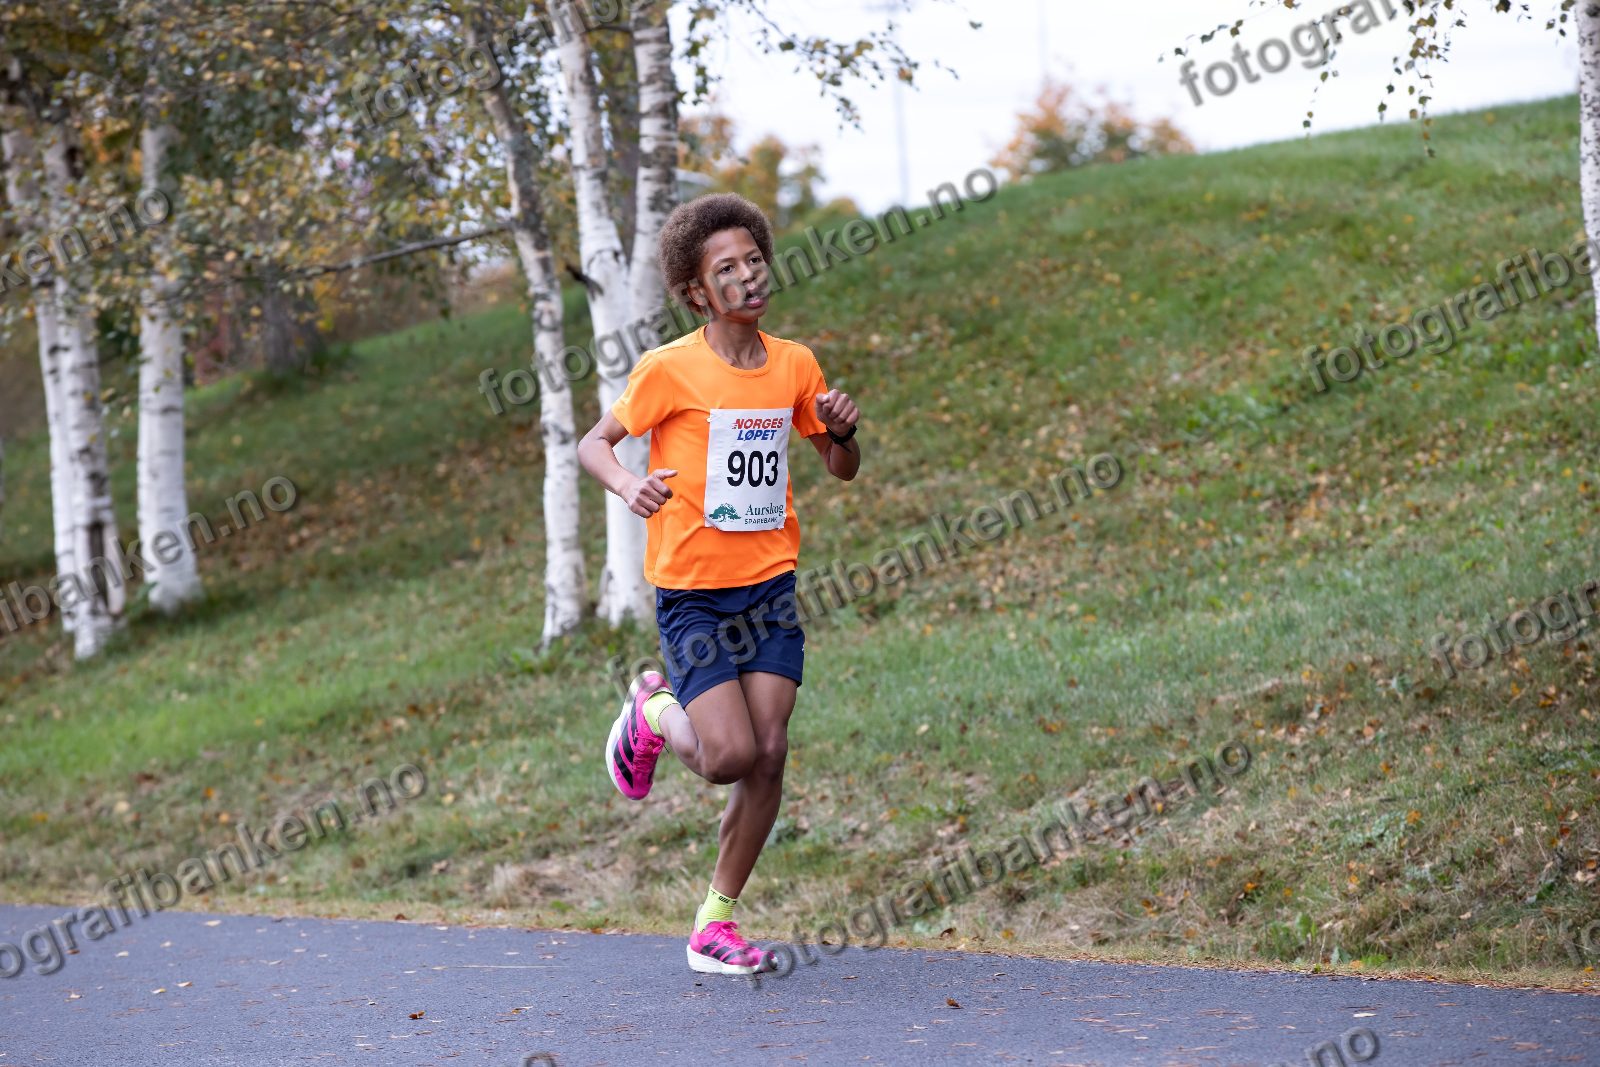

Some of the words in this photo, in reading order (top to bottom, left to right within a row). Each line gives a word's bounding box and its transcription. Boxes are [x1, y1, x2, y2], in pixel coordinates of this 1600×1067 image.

[735, 418, 783, 429] NORGES
[737, 429, 777, 441] LØPET
[727, 450, 778, 487] 903
[745, 503, 783, 516] Aurskog
